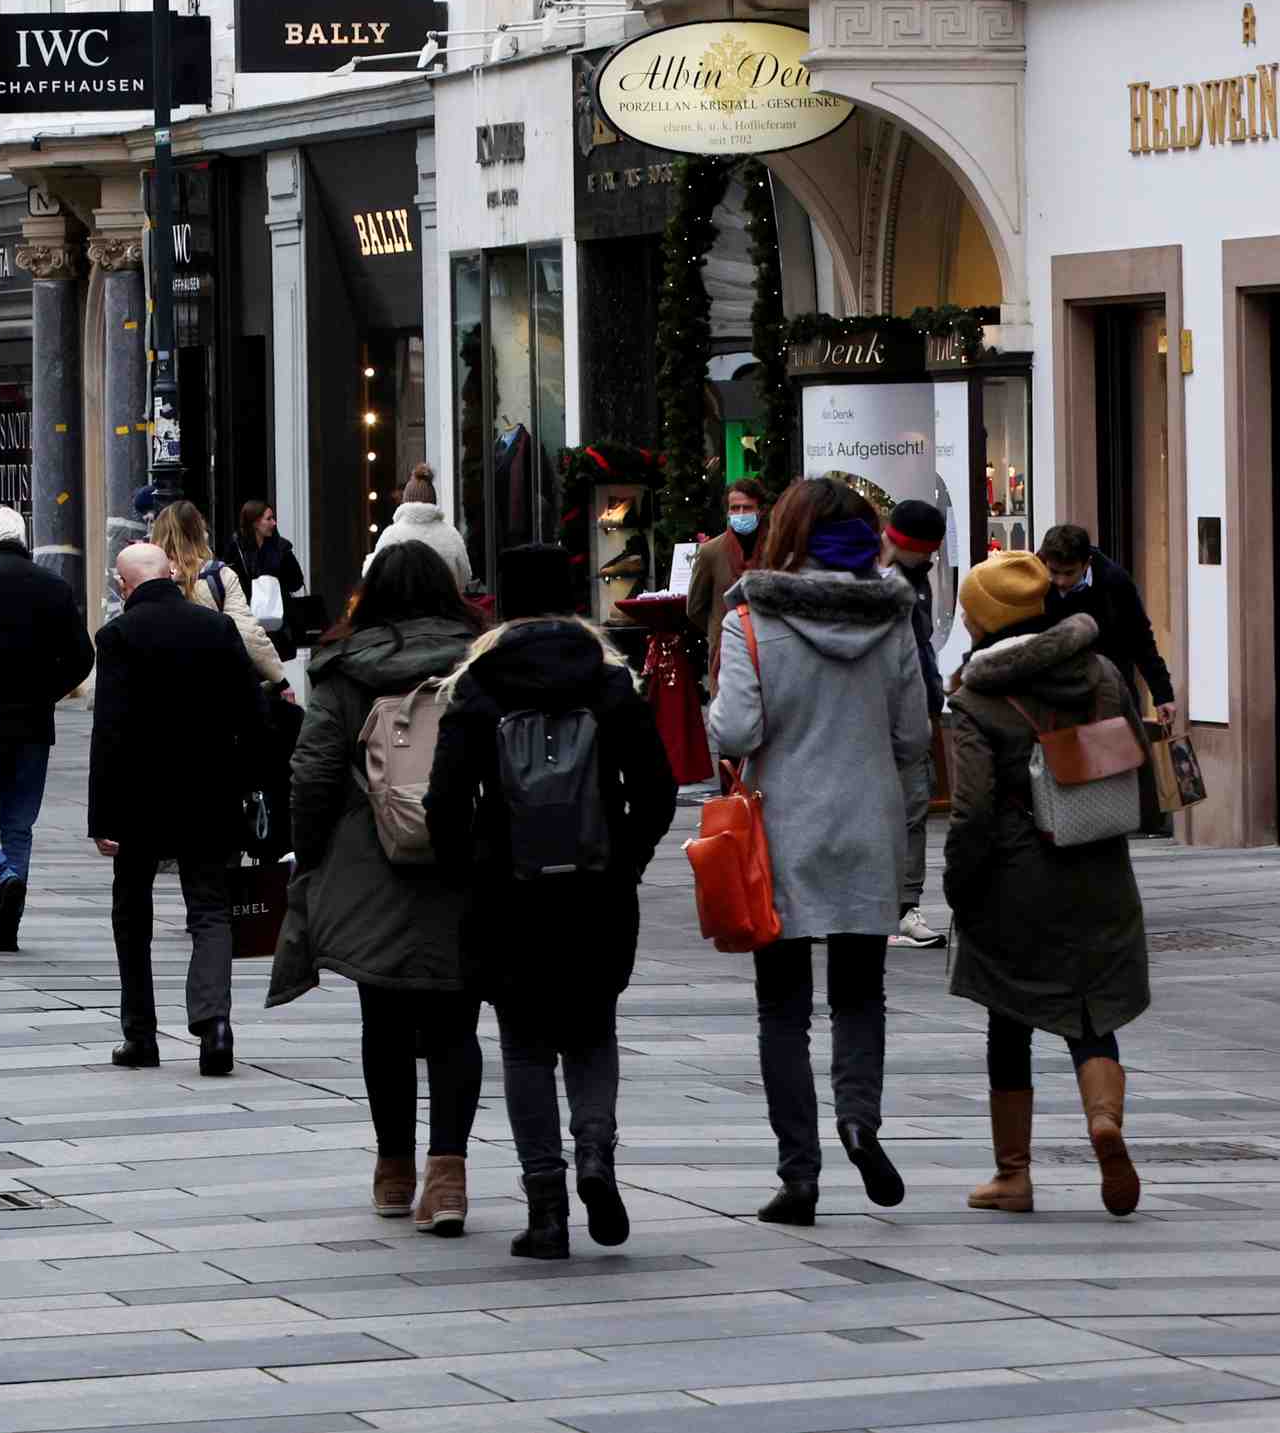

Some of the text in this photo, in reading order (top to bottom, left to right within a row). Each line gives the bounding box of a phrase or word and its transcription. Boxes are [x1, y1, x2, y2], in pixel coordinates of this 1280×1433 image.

[15, 29, 110, 68] IWC
[284, 22, 391, 45] BALLY
[618, 50, 811, 93] Albin Den
[618, 101, 690, 113] PORZELLAN
[700, 99, 758, 112] KRISTALL
[767, 96, 841, 110] GESCHENKE
[1127, 63, 1279, 156] HELDWEIN
[172, 224, 192, 264] WC
[353, 209, 413, 256] BALLY
[7, 412, 27, 449] NOT
[836, 439, 925, 460] Aufgetischt!
